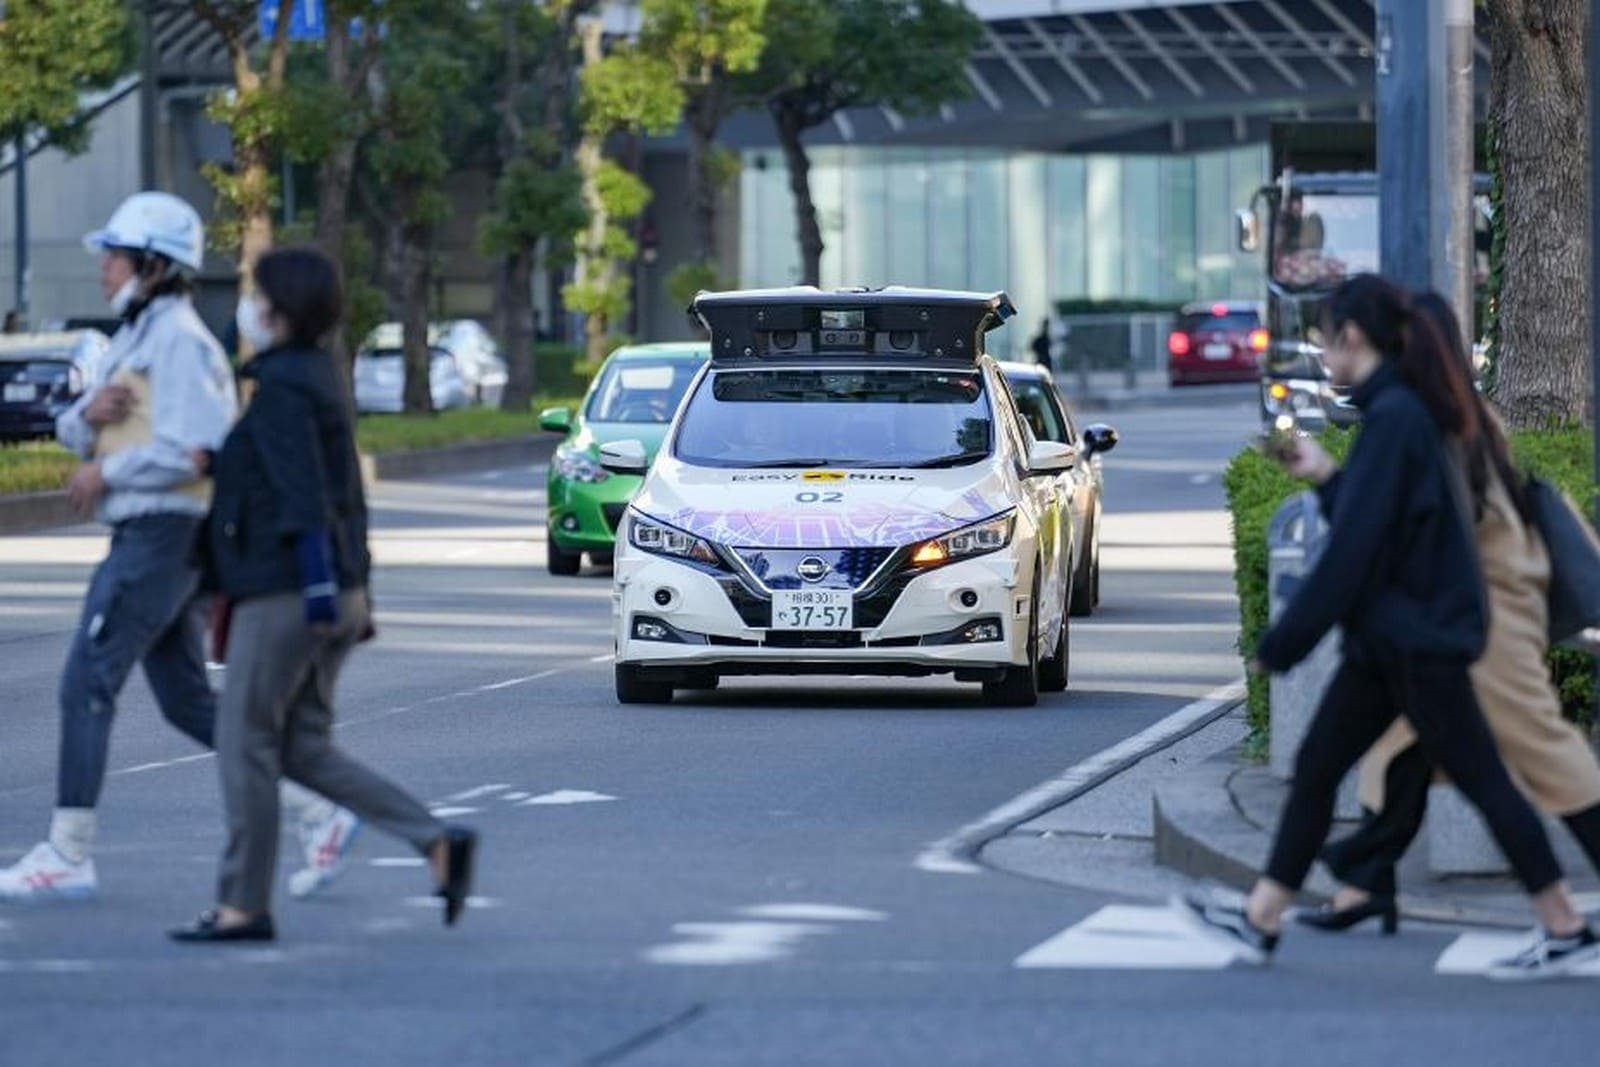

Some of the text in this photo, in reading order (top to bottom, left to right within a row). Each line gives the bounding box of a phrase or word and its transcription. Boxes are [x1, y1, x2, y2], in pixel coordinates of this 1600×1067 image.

[732, 473, 915, 481] Easy Ride
[795, 492, 844, 503] 02
[790, 606, 849, 627] 37-57
